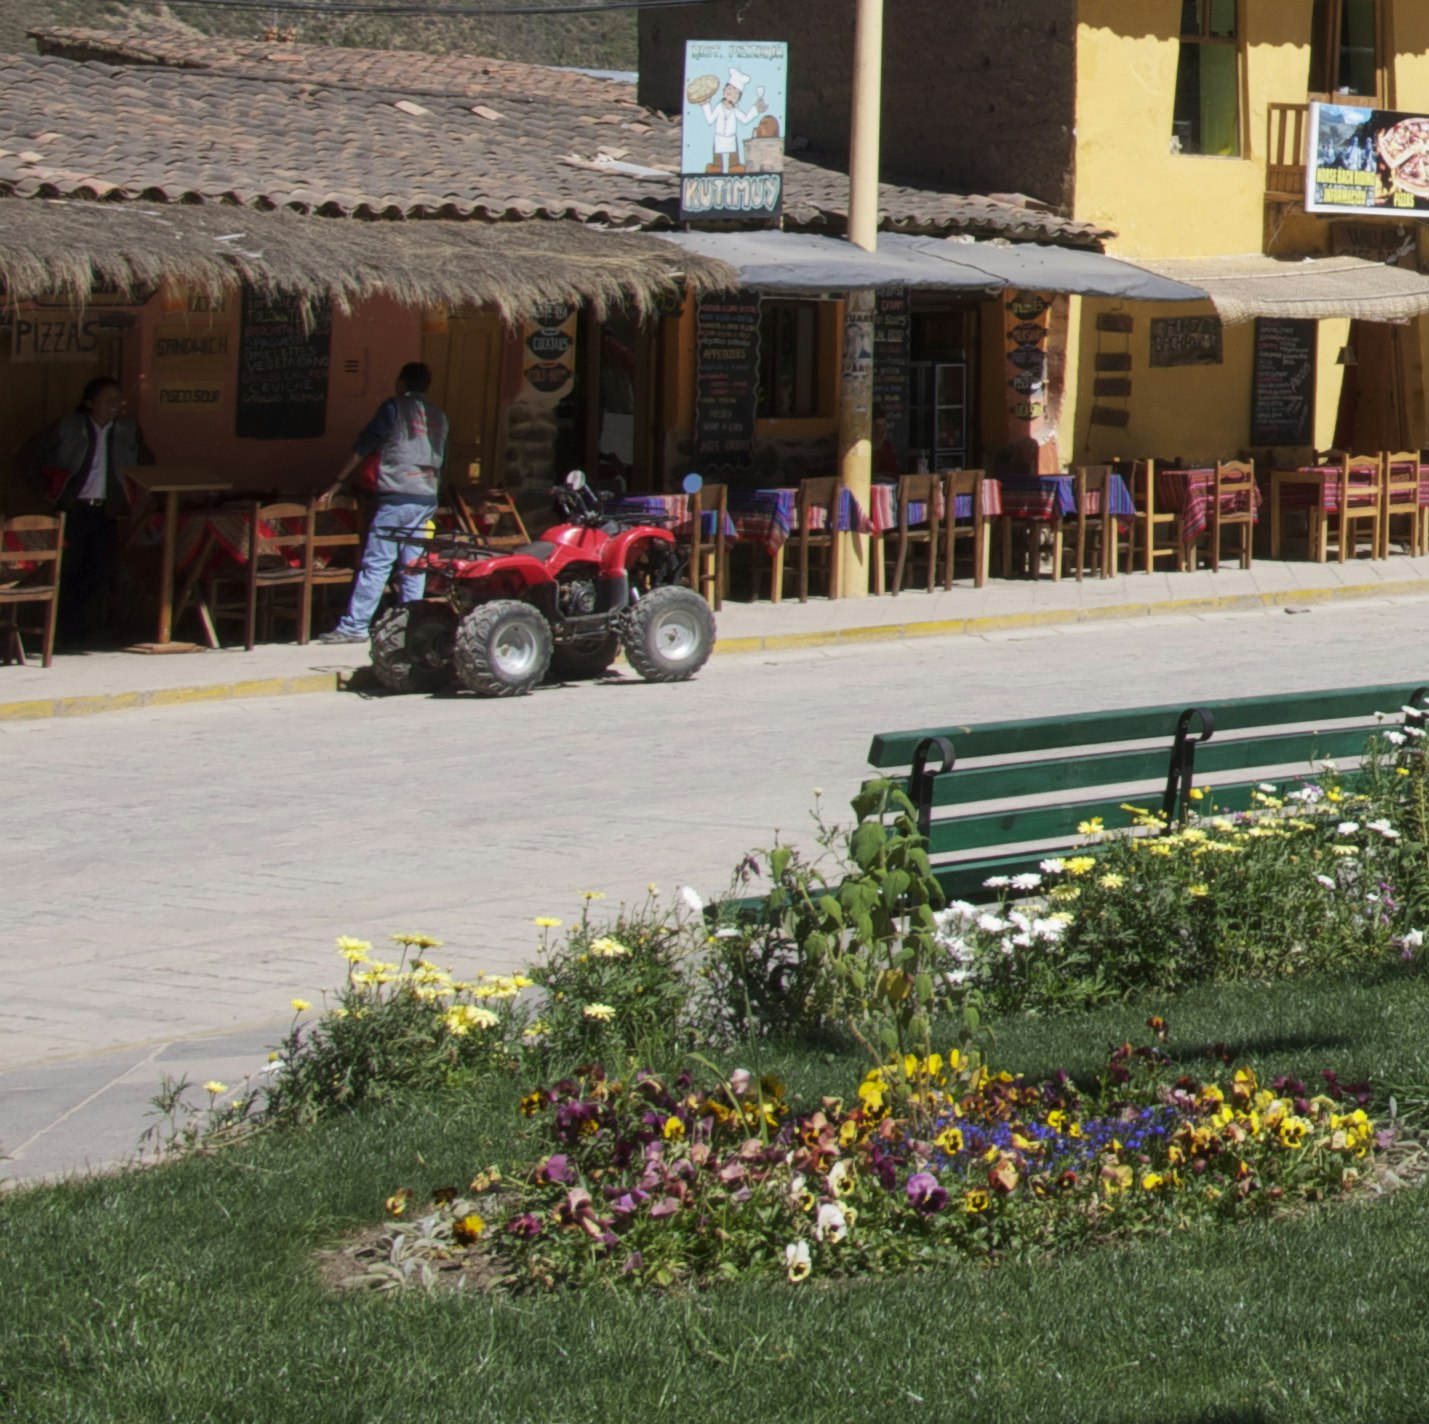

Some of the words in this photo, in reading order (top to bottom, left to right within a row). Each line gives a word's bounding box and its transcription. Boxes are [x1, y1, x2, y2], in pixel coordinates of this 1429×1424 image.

[683, 176, 781, 212] KUTIMUY
[16, 318, 97, 355] PIZZAS
[156, 336, 228, 357] SANDWICH
[160, 388, 193, 404] PISCO
[193, 389, 221, 404] SOUR
[249, 379, 315, 395] CEVICHE
